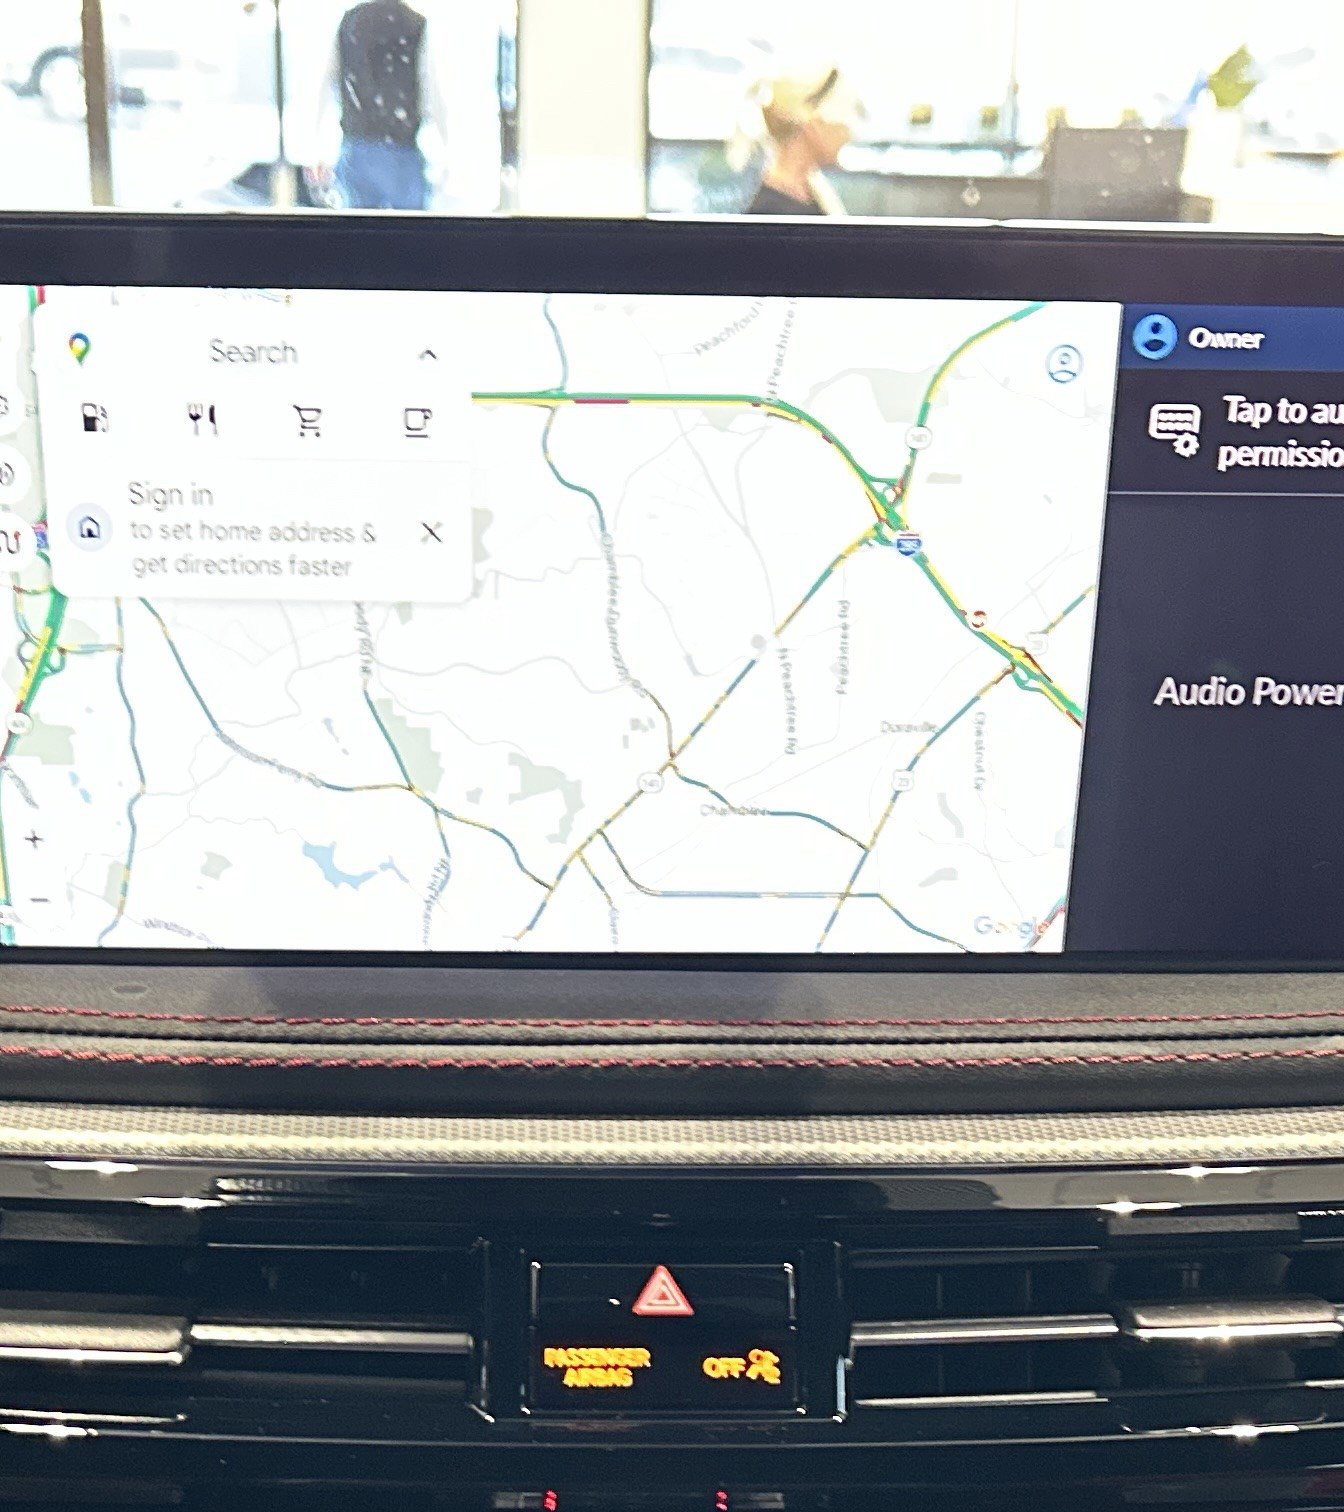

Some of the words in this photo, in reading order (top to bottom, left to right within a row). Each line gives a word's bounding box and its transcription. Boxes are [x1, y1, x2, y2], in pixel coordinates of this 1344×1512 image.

[1188, 326, 1266, 350] Owner
[209, 338, 299, 364] Search
[1222, 394, 1273, 429] Tap
[1276, 397, 1306, 425] to
[127, 481, 183, 512] Sign
[191, 482, 214, 506] in
[130, 521, 153, 541] to
[159, 522, 191, 542] set
[199, 521, 261, 542] home
[268, 521, 355, 543] address
[360, 523, 377, 543] &
[132, 555, 168, 579] get
[174, 555, 283, 577] directions
[288, 556, 353, 578] faster
[1153, 677, 1246, 707] Audio
[974, 915, 1052, 941] Ggle
[544, 1348, 650, 1367] PASSENGER
[703, 1357, 746, 1378] OFF
